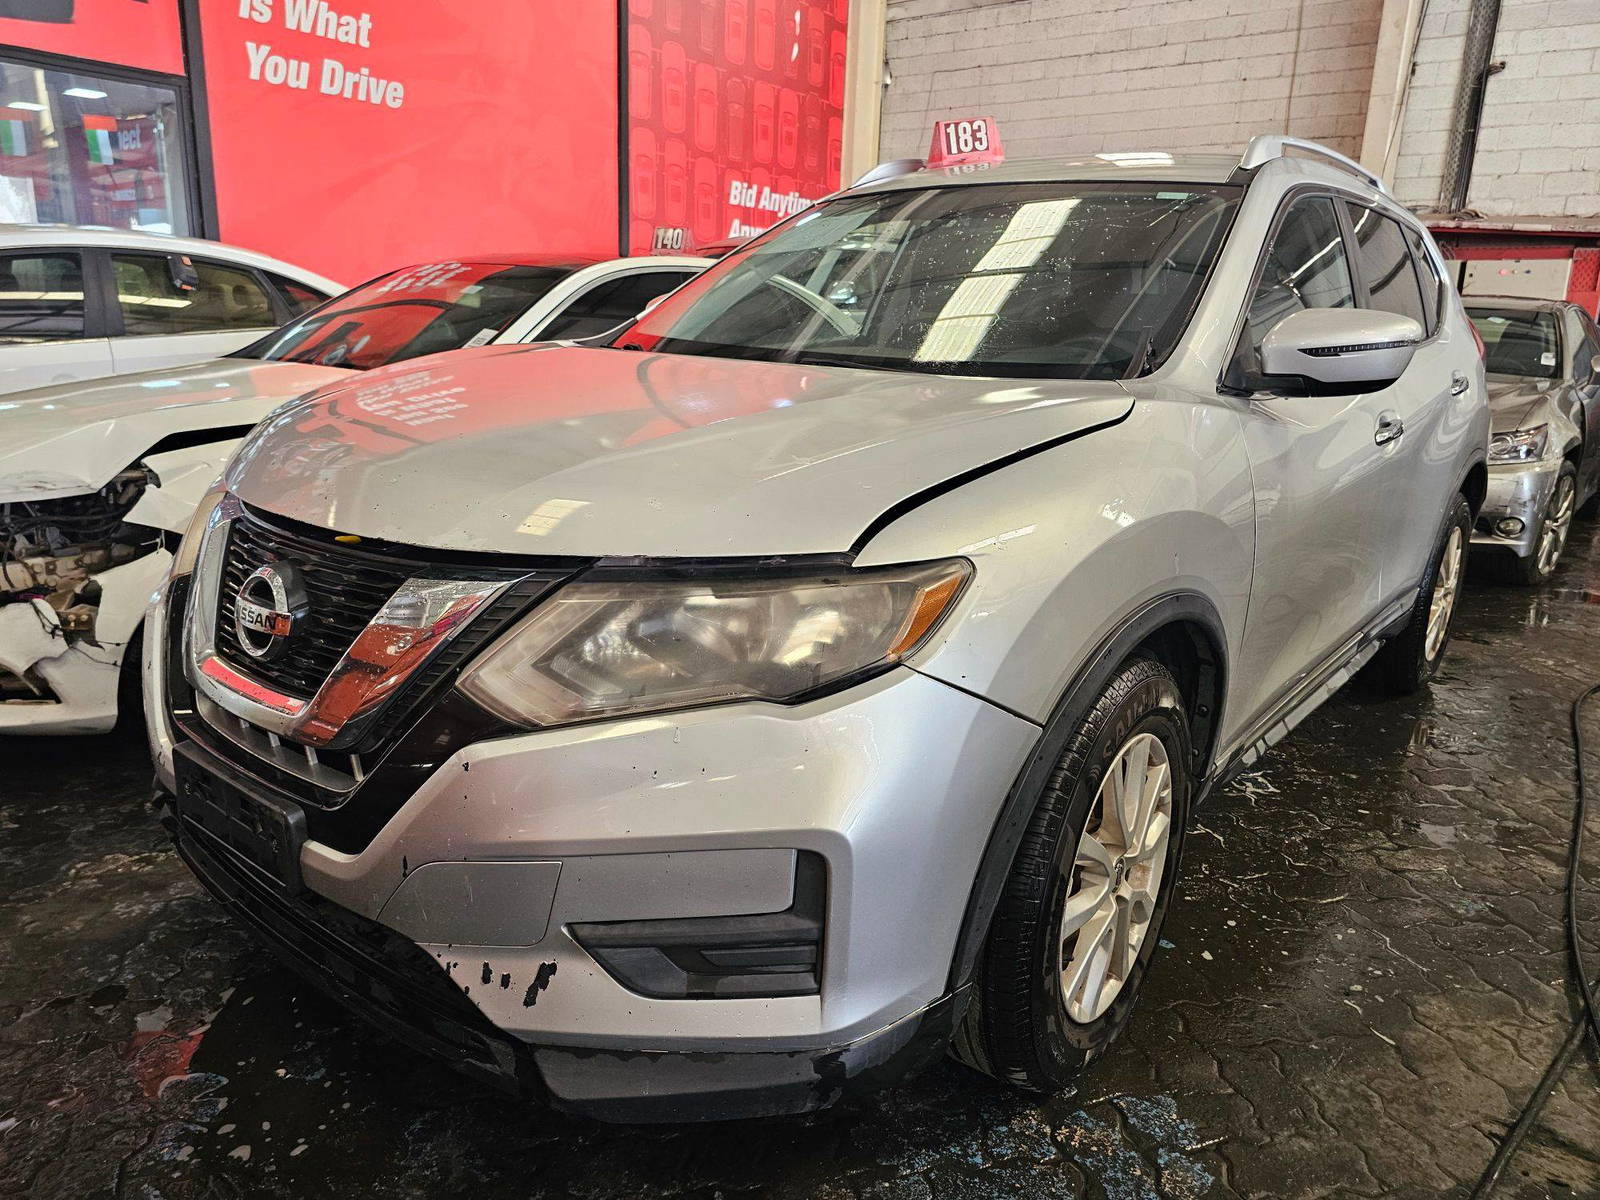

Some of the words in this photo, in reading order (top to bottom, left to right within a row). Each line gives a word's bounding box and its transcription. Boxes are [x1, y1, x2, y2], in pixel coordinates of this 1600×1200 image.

[284, 0, 373, 48] What
[245, 40, 310, 89] You
[320, 58, 405, 109] Drive
[946, 119, 988, 155] 183
[728, 180, 757, 208] Bid
[758, 185, 812, 218] Anytim
[656, 228, 684, 249] 140
[236, 603, 276, 630] SSAN
